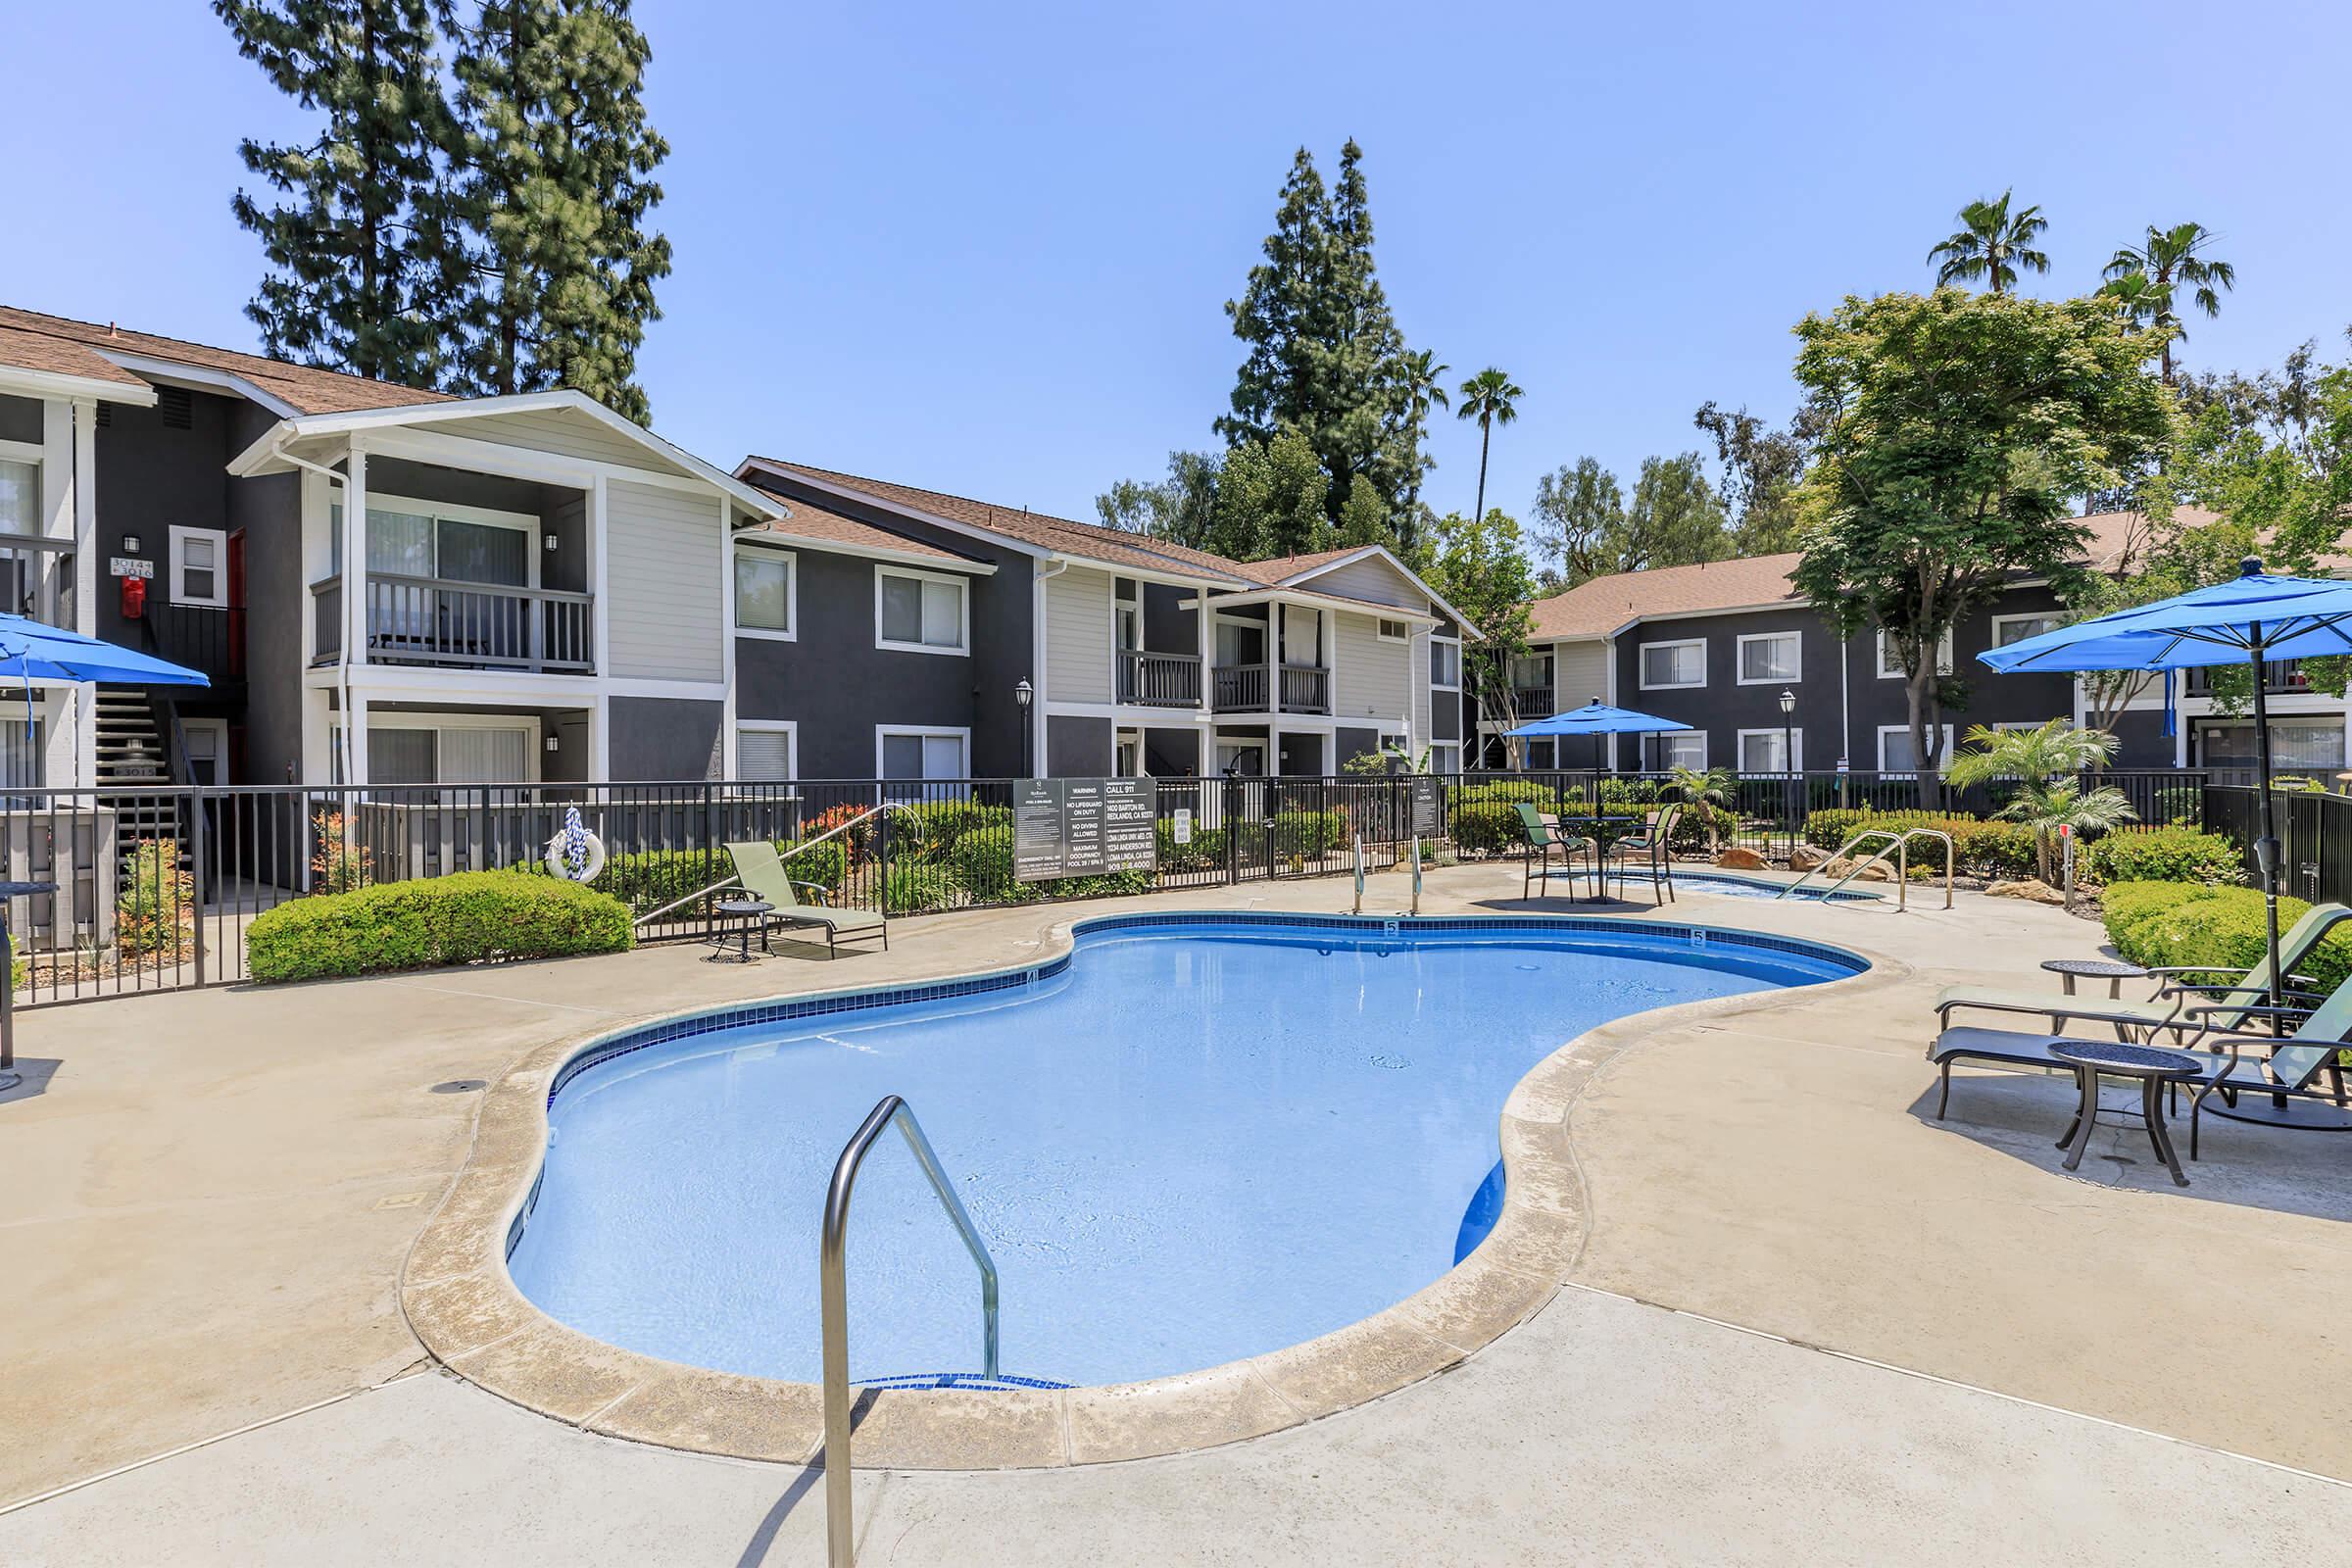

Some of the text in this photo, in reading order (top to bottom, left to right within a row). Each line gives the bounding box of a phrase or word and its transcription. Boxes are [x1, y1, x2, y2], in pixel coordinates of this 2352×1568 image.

[114, 560, 143, 568] 3014
[122, 568, 152, 577] 3016
[1107, 812, 1133, 820] REDLANDS,
[1388, 922, 1396, 933] 5
[1694, 931, 1703, 942] 5
